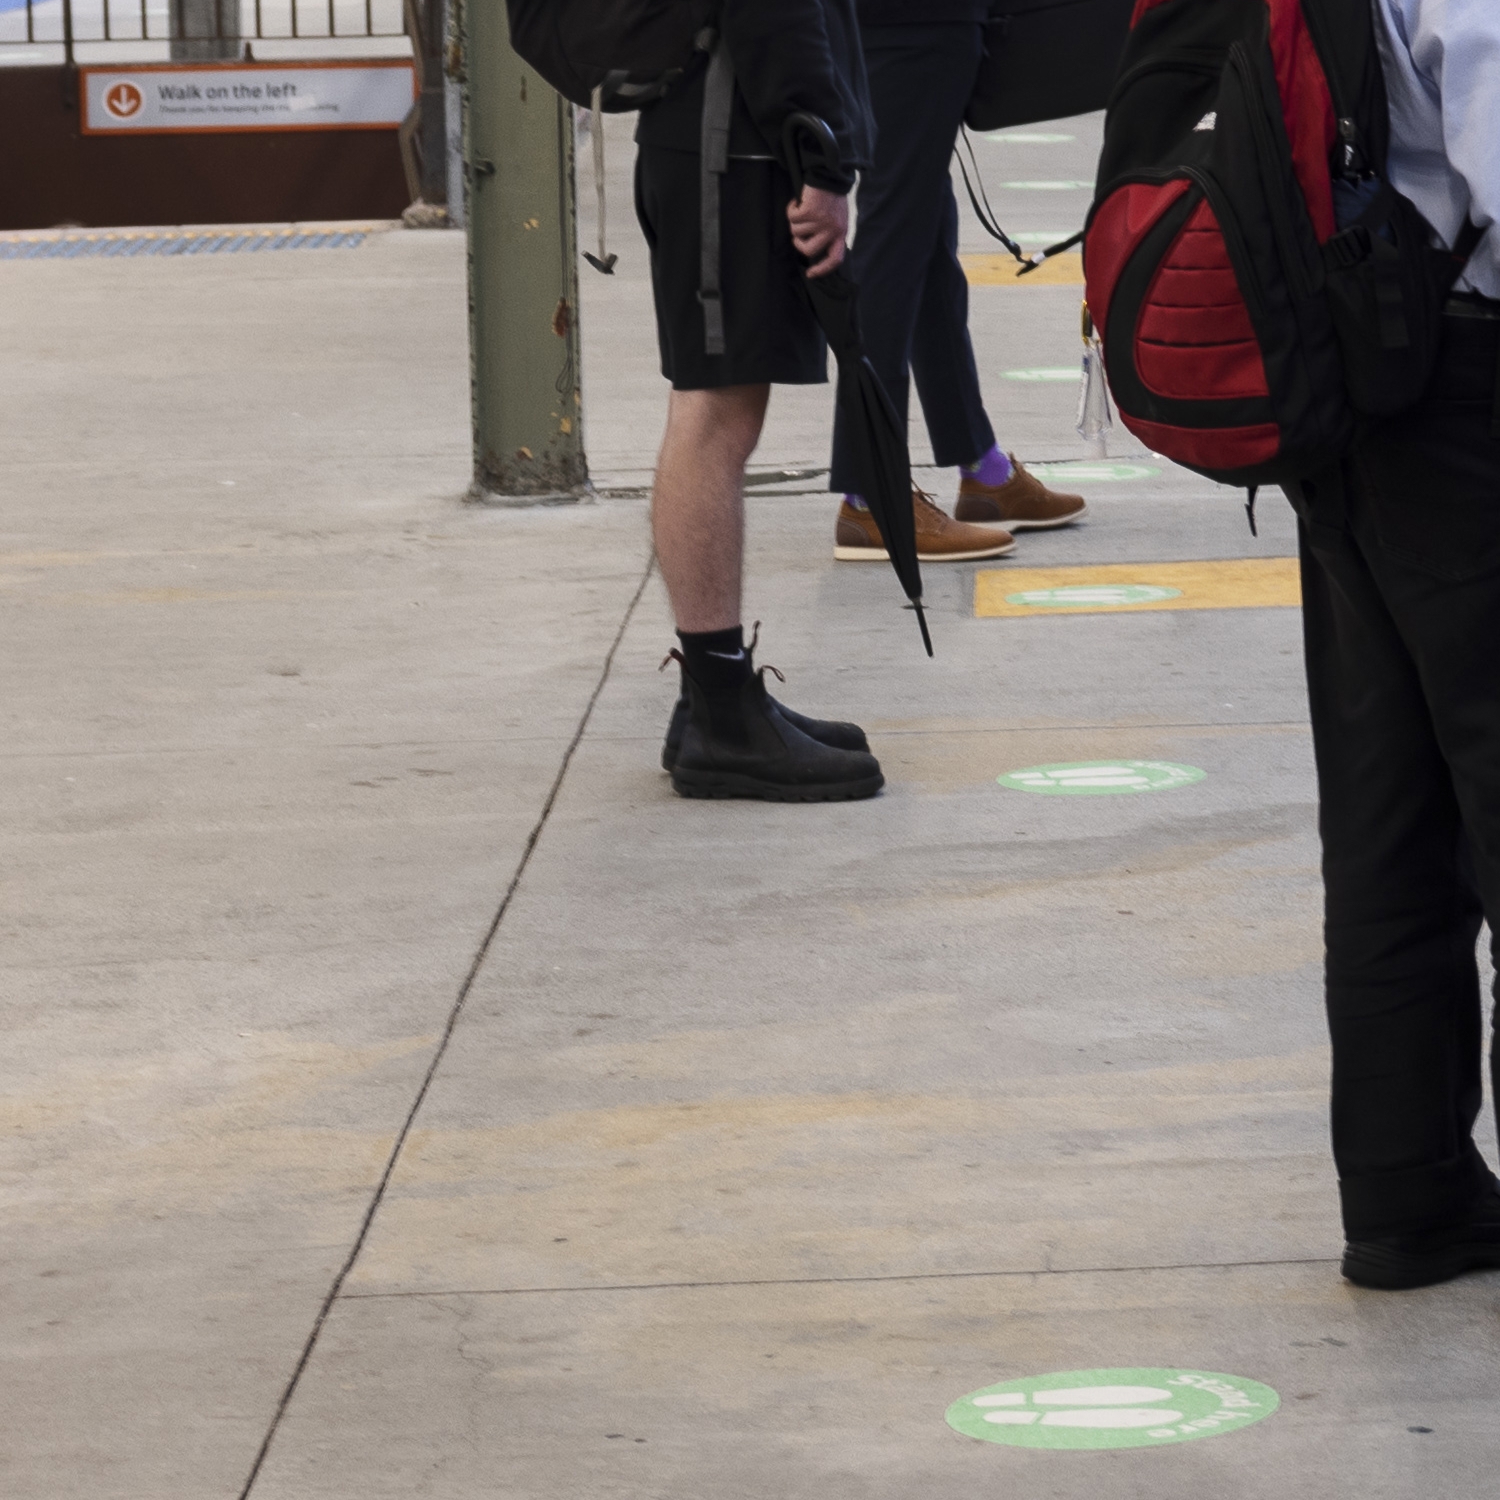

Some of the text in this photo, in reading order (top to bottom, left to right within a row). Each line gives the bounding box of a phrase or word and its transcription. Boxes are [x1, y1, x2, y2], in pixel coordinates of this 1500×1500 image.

[157, 82, 297, 100] Walk on the left
[1146, 1374, 1263, 1439] Stand here
